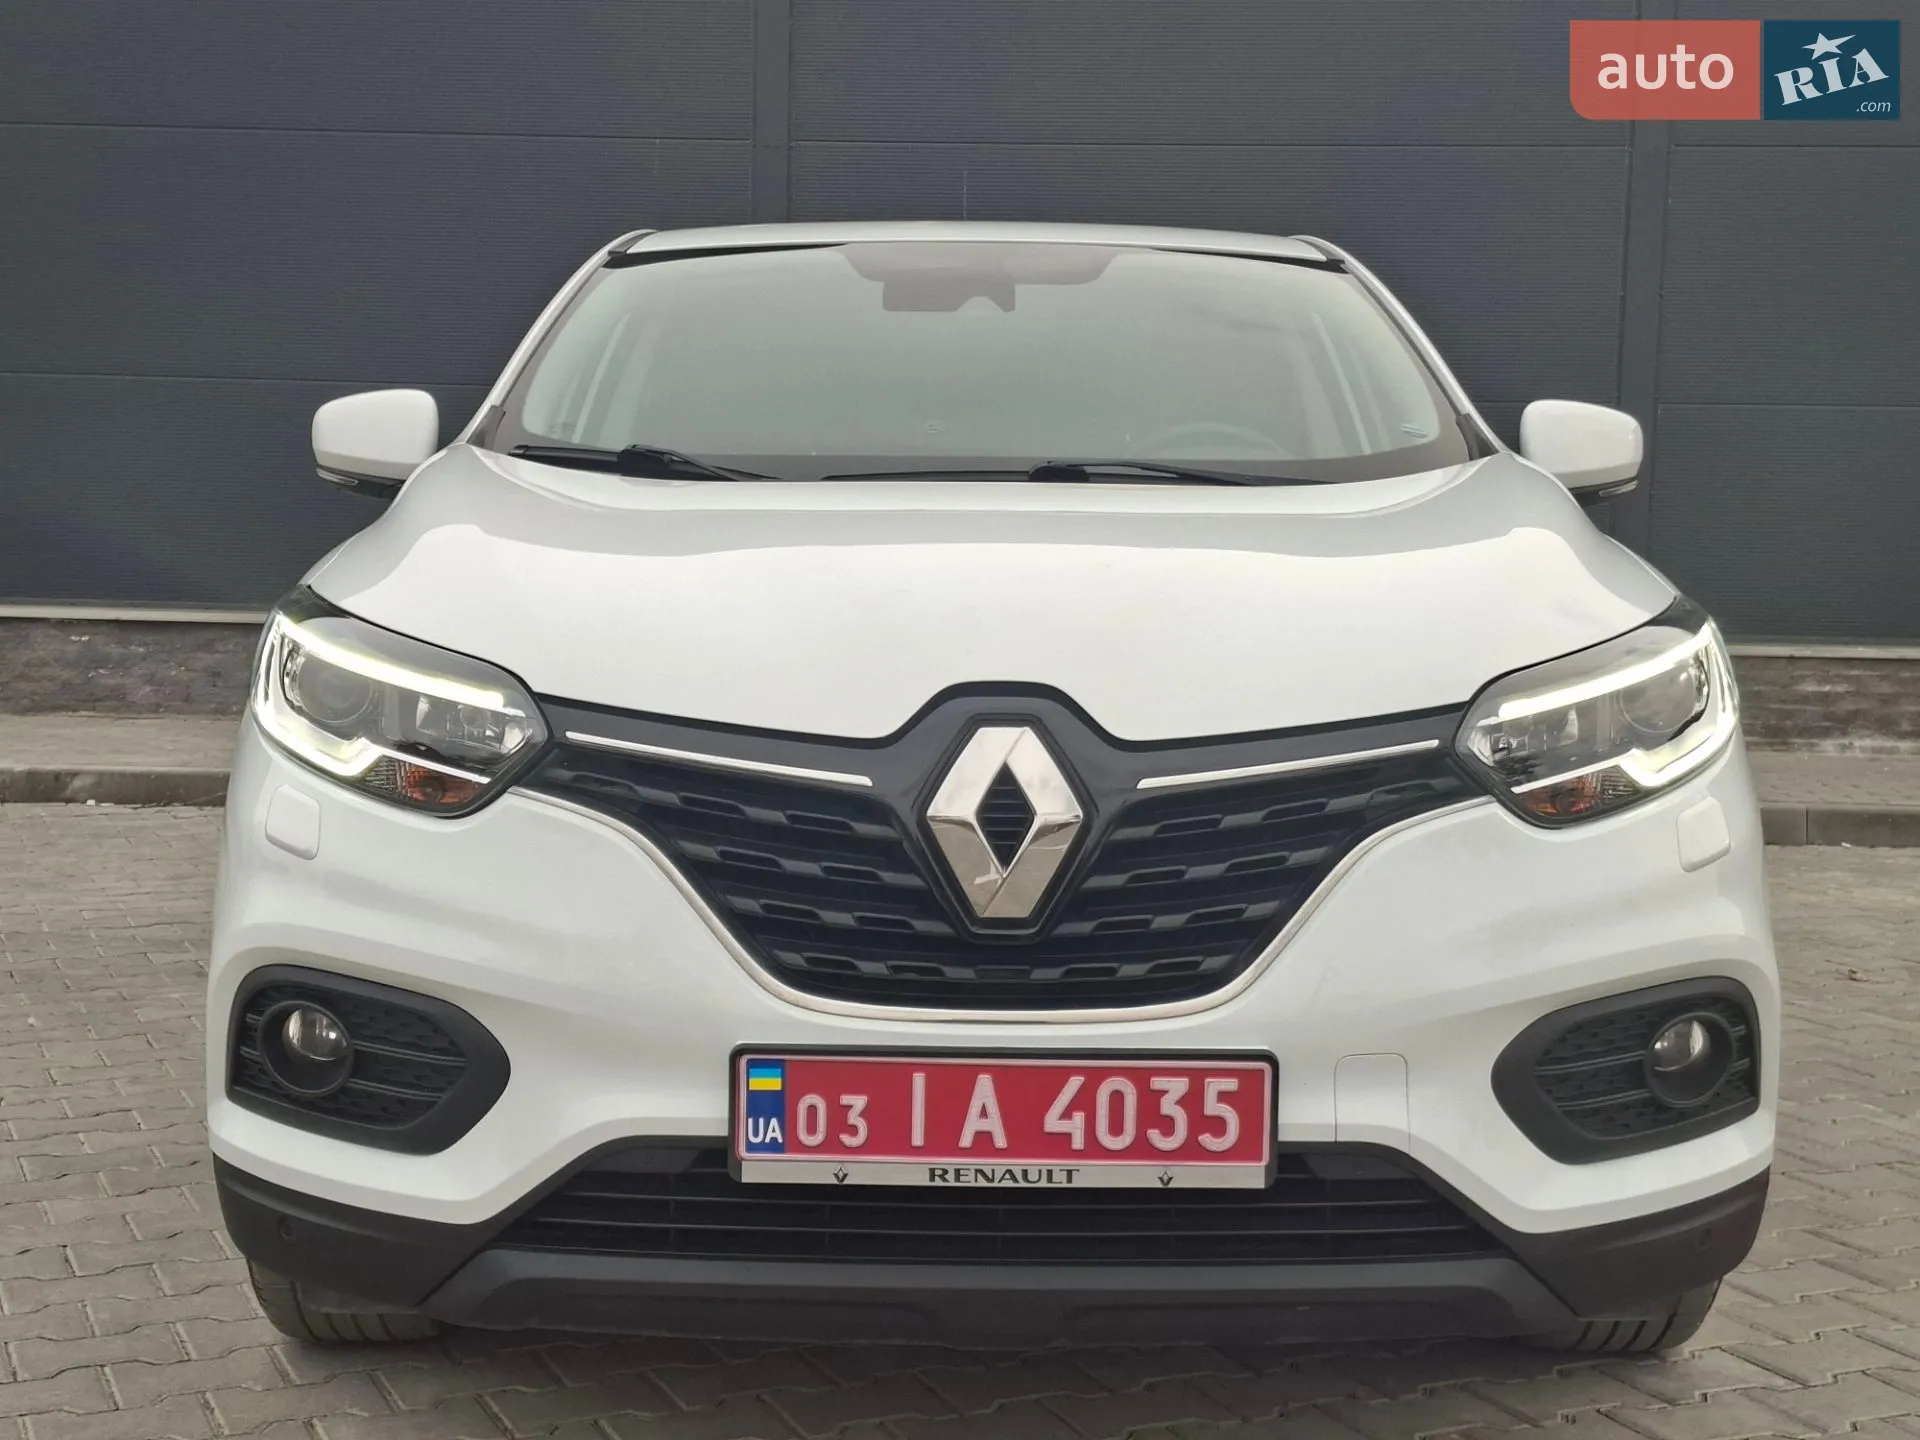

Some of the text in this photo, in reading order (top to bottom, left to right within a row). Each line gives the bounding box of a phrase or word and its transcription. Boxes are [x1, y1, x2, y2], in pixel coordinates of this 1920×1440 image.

[796, 1093, 868, 1148] 03
[1043, 1075, 1240, 1152] 4035
[747, 1117, 783, 1143] UA
[928, 1167, 1080, 1185] RENAULT
